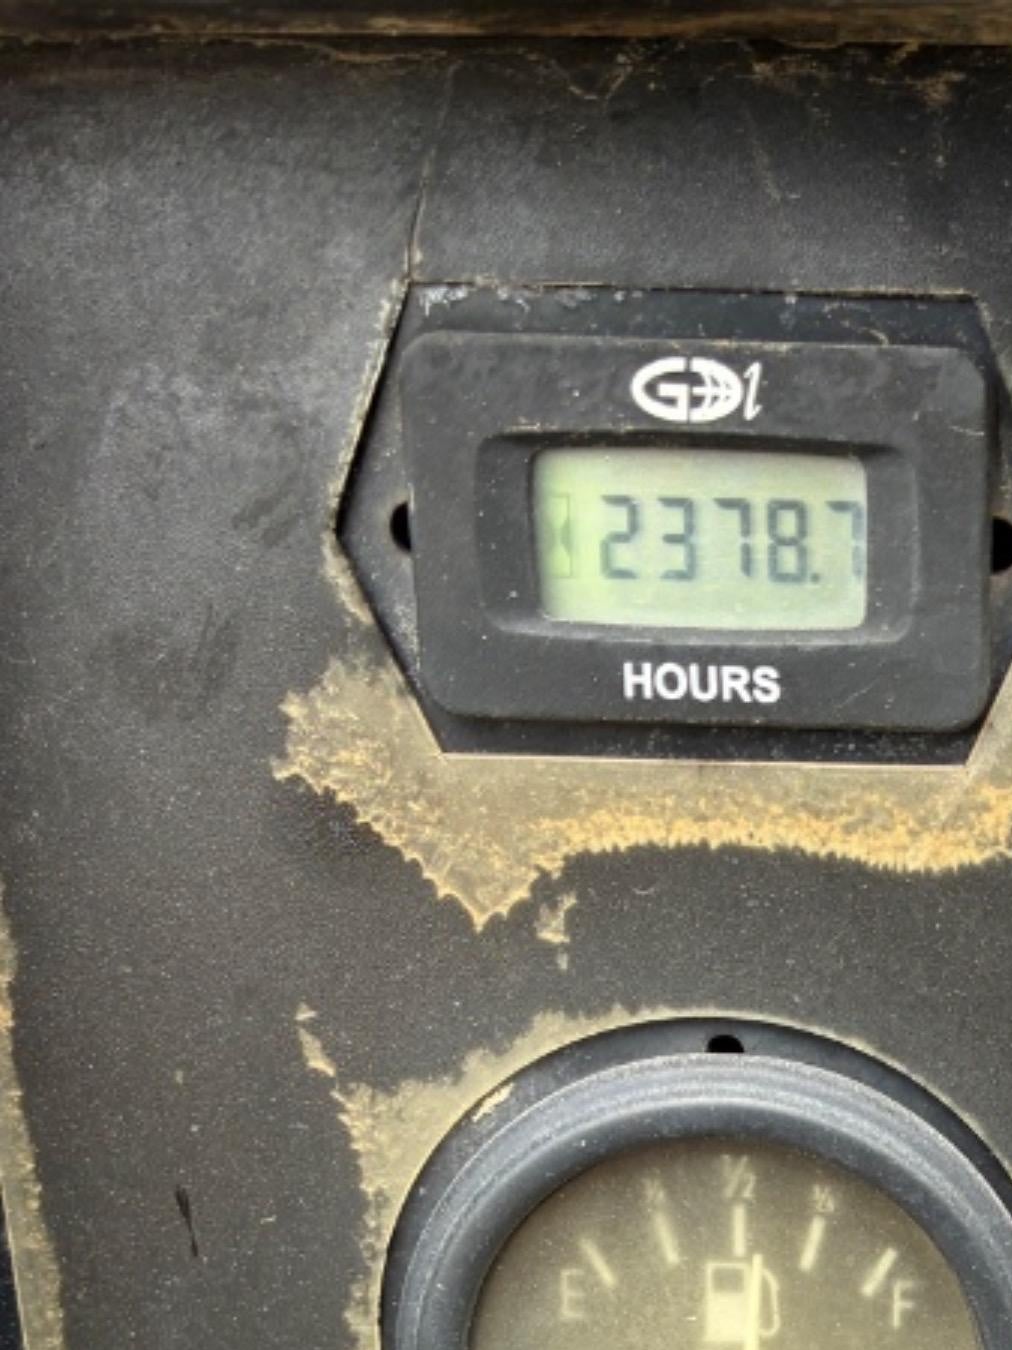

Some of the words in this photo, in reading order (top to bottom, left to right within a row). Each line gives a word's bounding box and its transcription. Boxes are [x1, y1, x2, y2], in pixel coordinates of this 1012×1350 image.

[599, 494, 865, 583] 2378.7
[622, 662, 782, 702] HOURS
[560, 1269, 585, 1321] E
[894, 1281, 916, 1330] F
